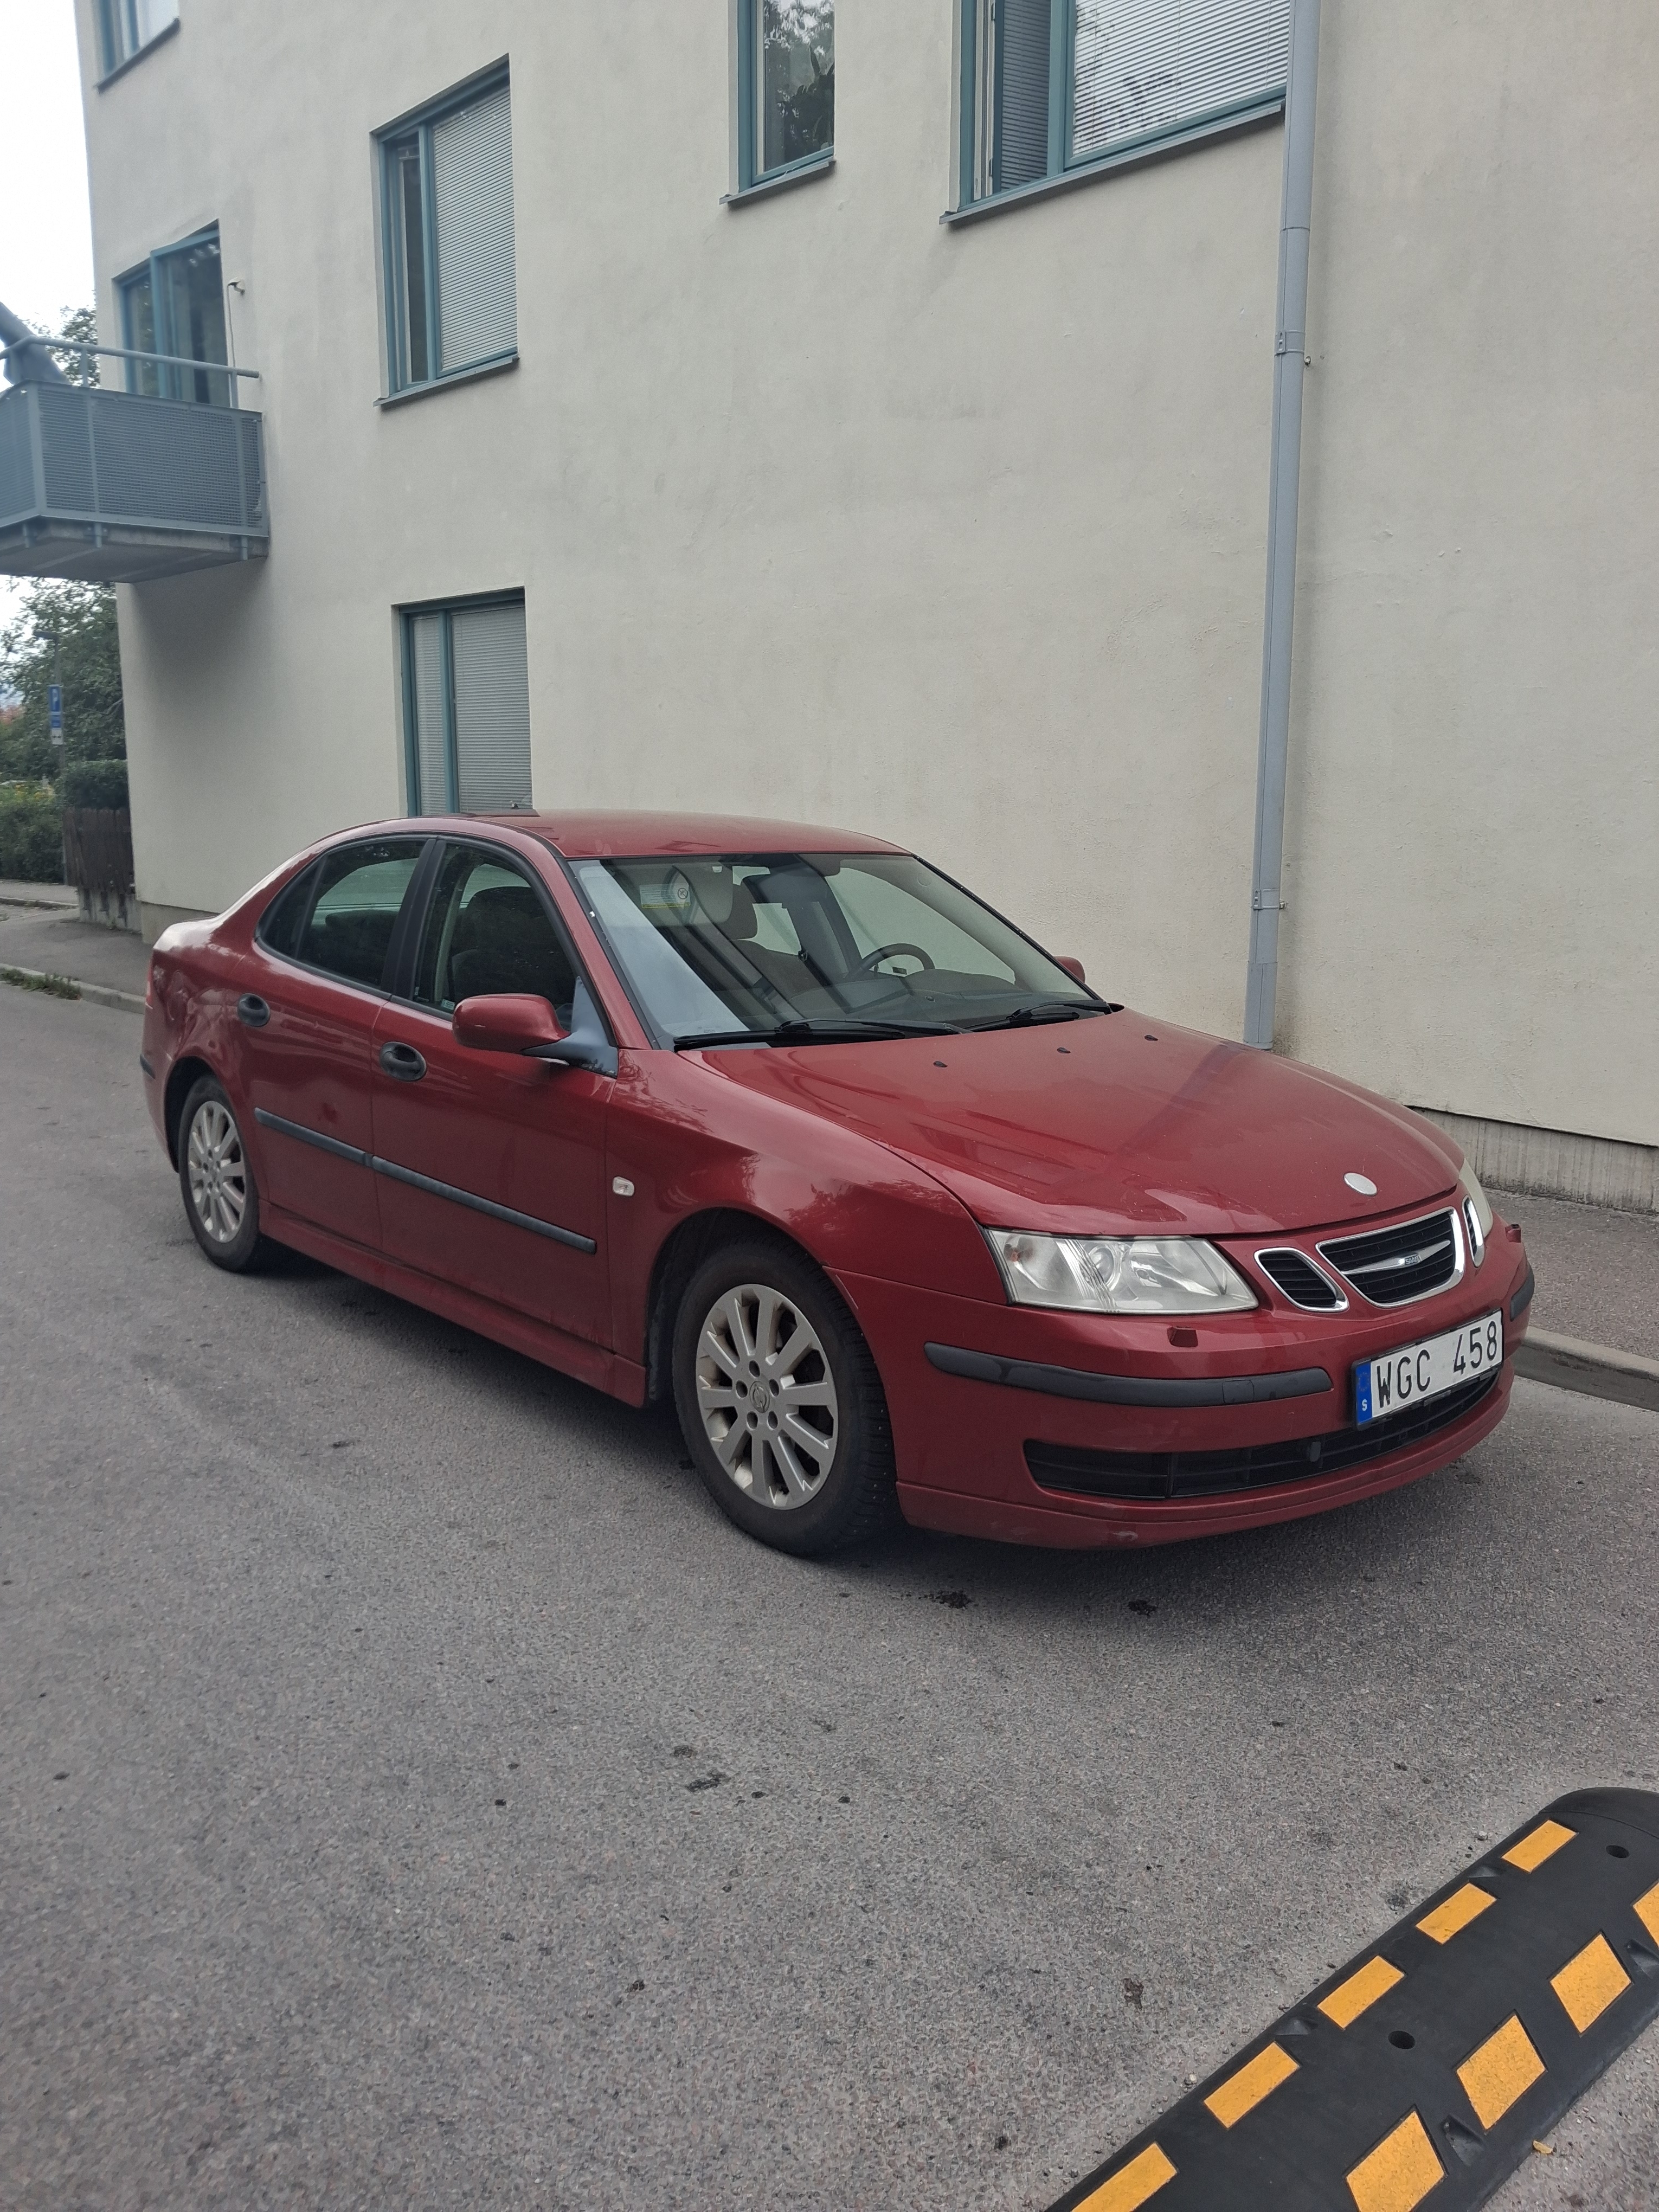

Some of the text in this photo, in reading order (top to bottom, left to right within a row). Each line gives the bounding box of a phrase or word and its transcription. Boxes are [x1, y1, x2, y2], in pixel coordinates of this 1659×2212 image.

[52, 689, 58, 710] P
[1405, 1255, 1419, 1264] SAAB
[1377, 1321, 1497, 1408] WGC 458
[1361, 1399, 1367, 1411] S
